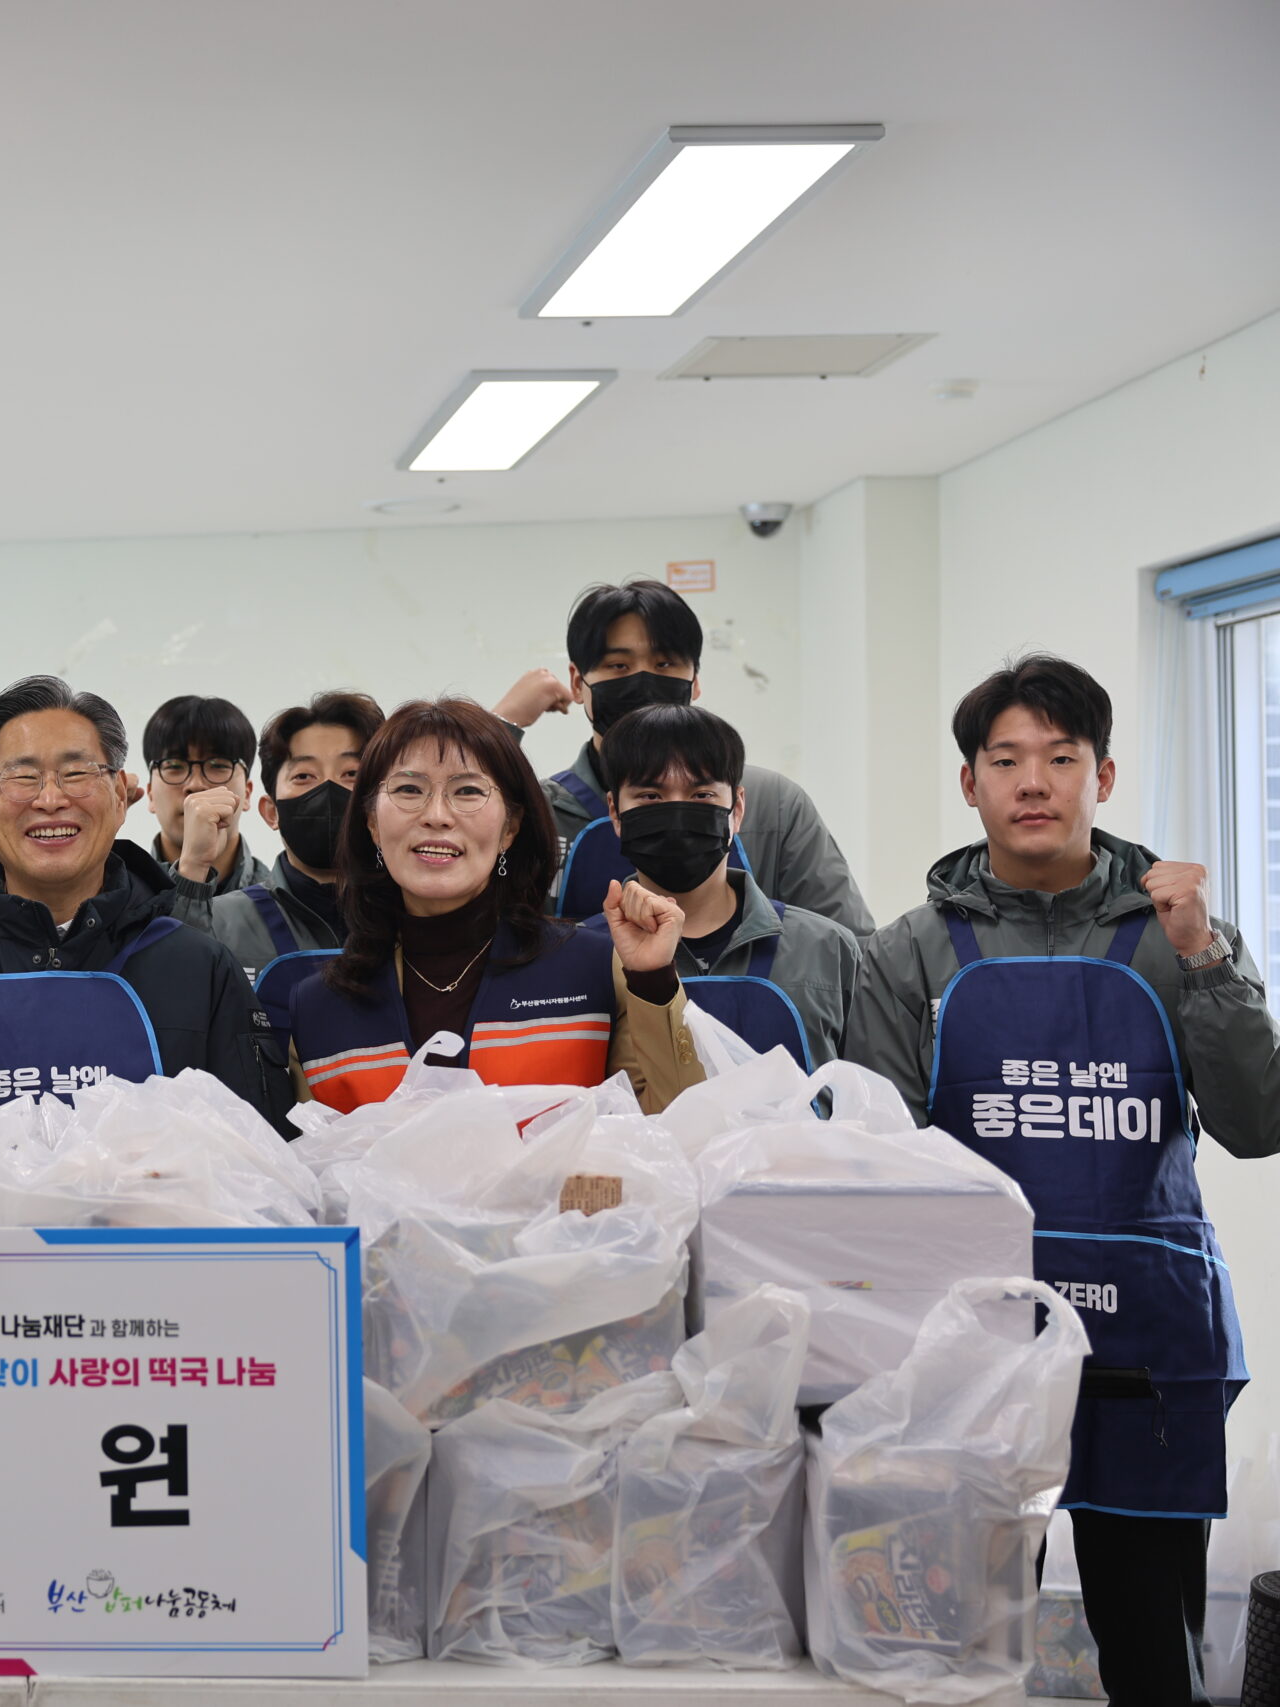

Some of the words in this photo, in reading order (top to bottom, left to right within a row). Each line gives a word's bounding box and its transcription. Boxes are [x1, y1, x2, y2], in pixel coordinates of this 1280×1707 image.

[1001, 1059, 1060, 1087] 좋은
[1069, 1061, 1129, 1089] 날엔
[972, 1093, 1162, 1143] 좋은데이
[112, 1319, 180, 1338] 함께하는
[49, 1357, 140, 1388] 사랑의
[149, 1357, 209, 1387] 떡국
[217, 1356, 277, 1387] 나눔
[99, 1423, 190, 1527] 원
